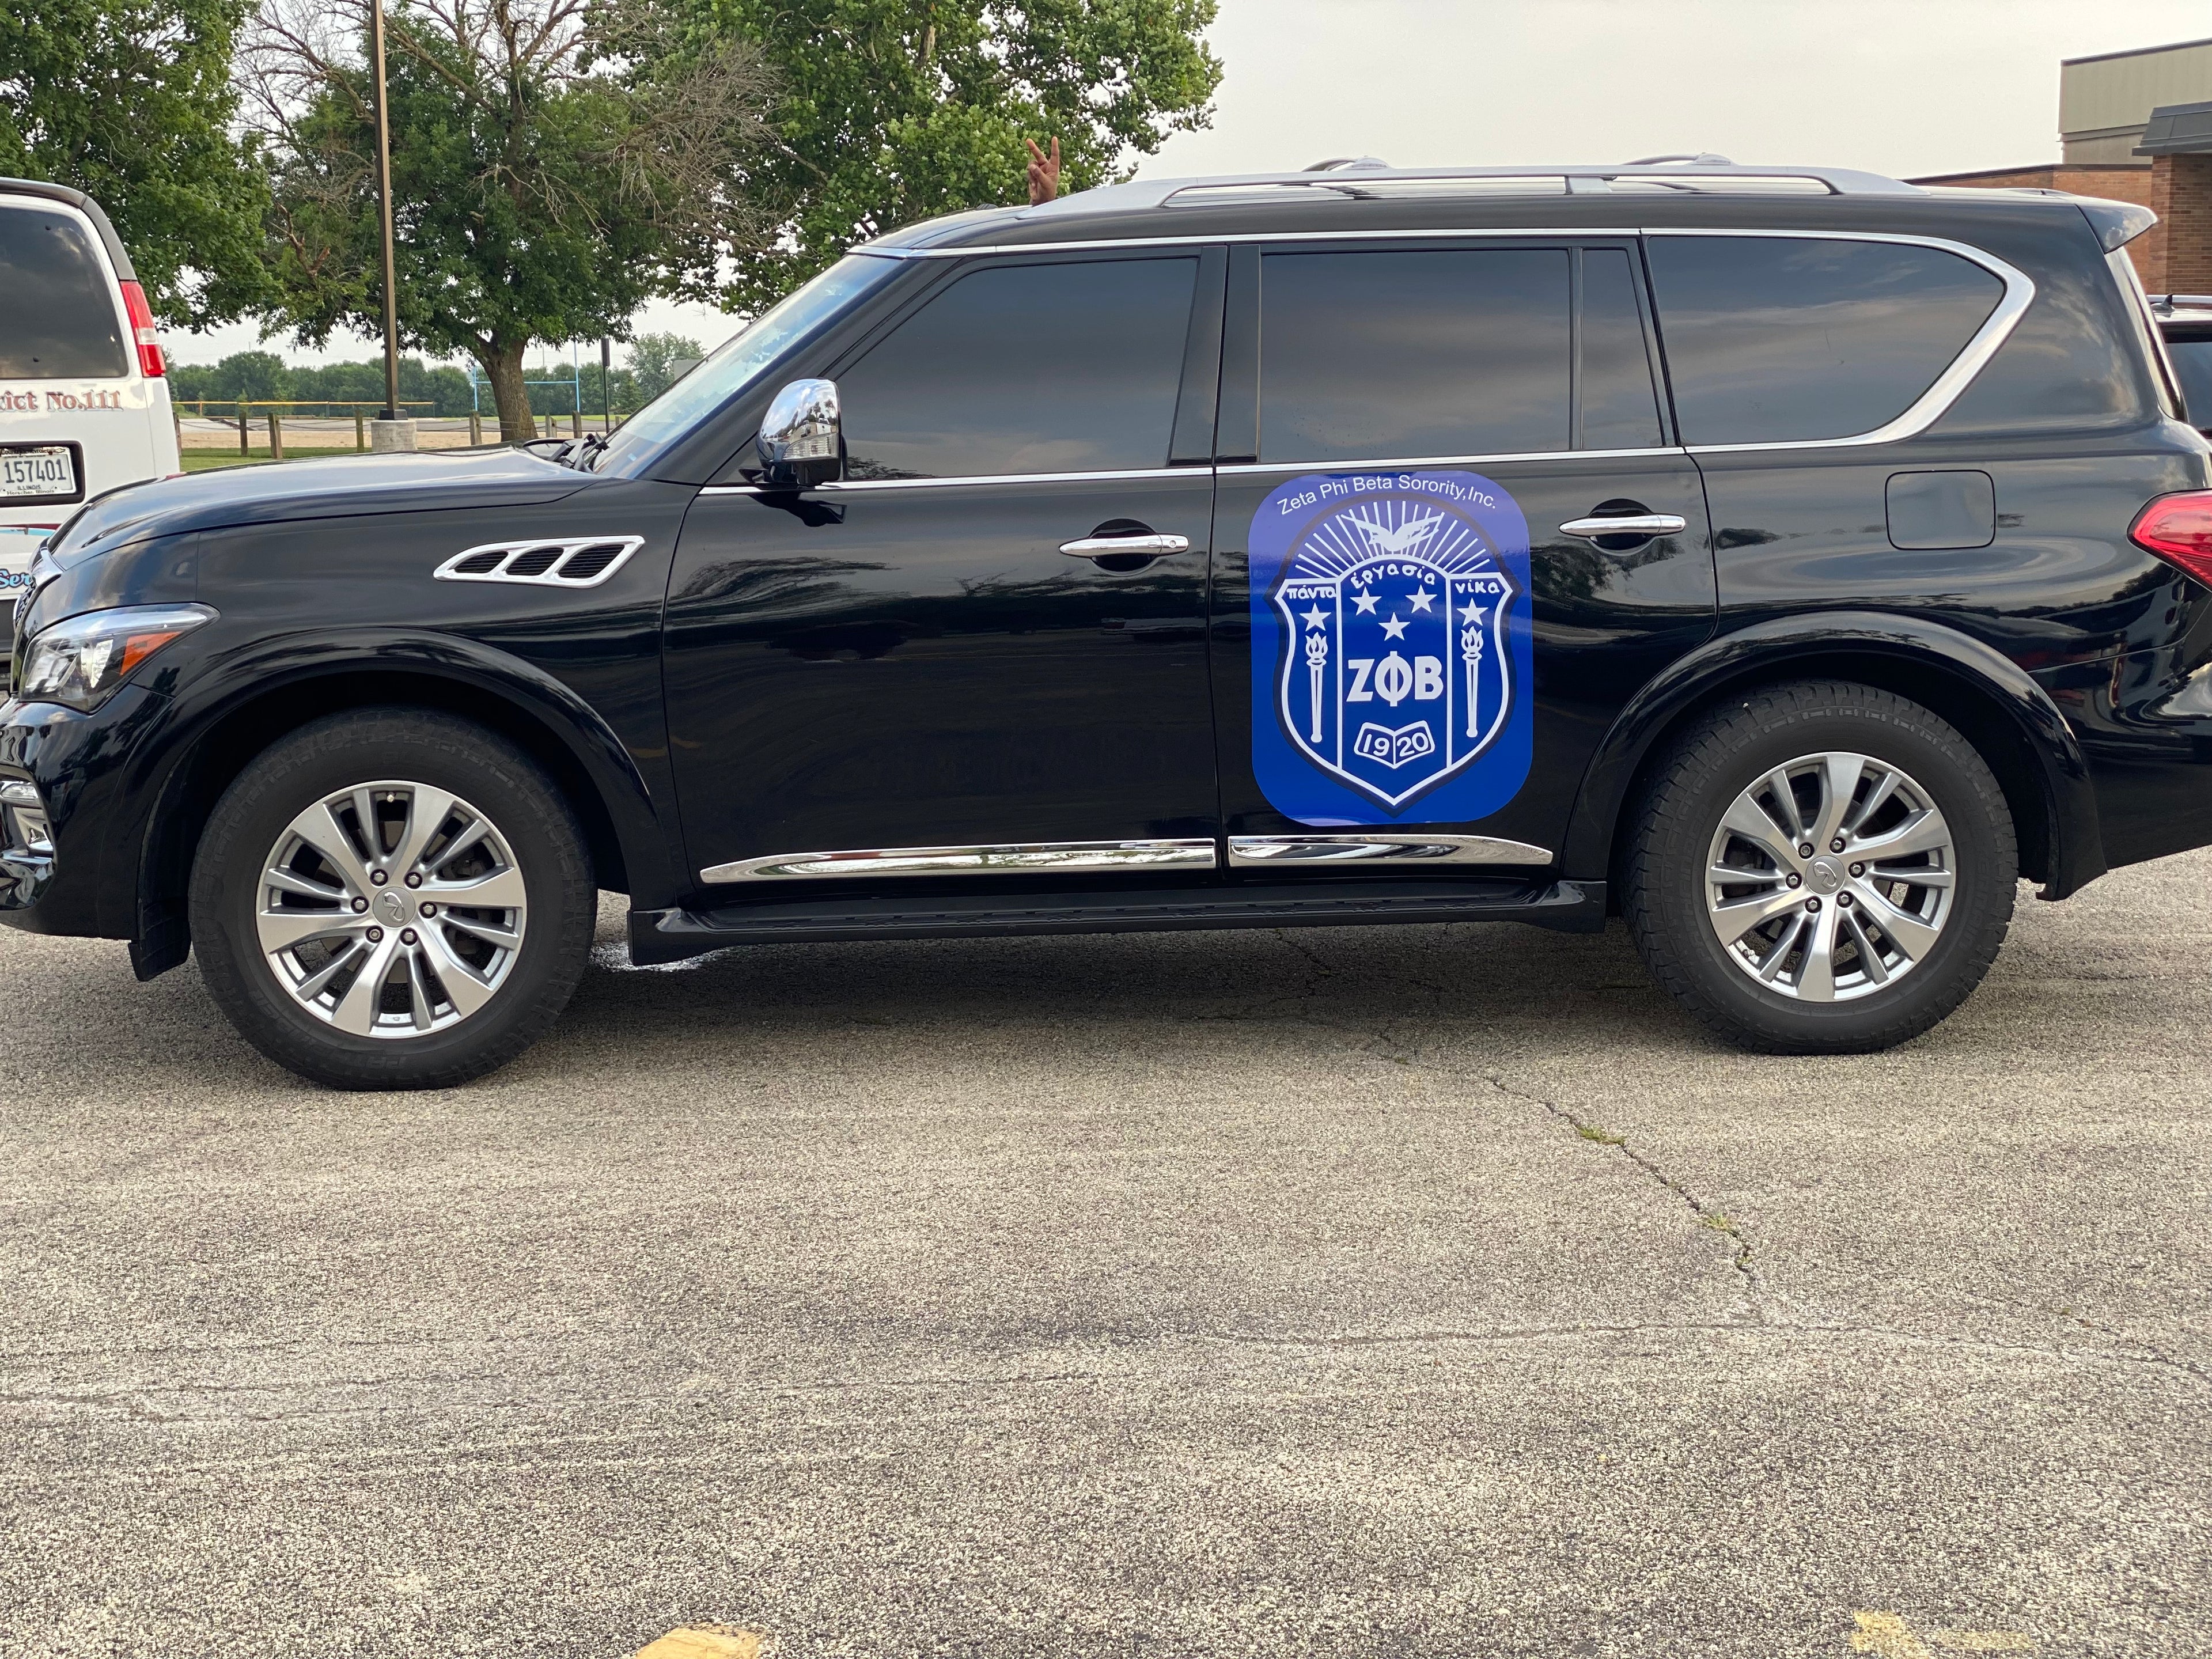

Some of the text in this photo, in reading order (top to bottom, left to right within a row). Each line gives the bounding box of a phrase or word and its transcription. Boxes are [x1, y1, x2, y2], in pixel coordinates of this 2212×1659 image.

[46, 389, 124, 412] No.111
[5, 459, 66, 483] 157401
[1277, 474, 1497, 516] Zeta Phi Beta Sorority,Inc.
